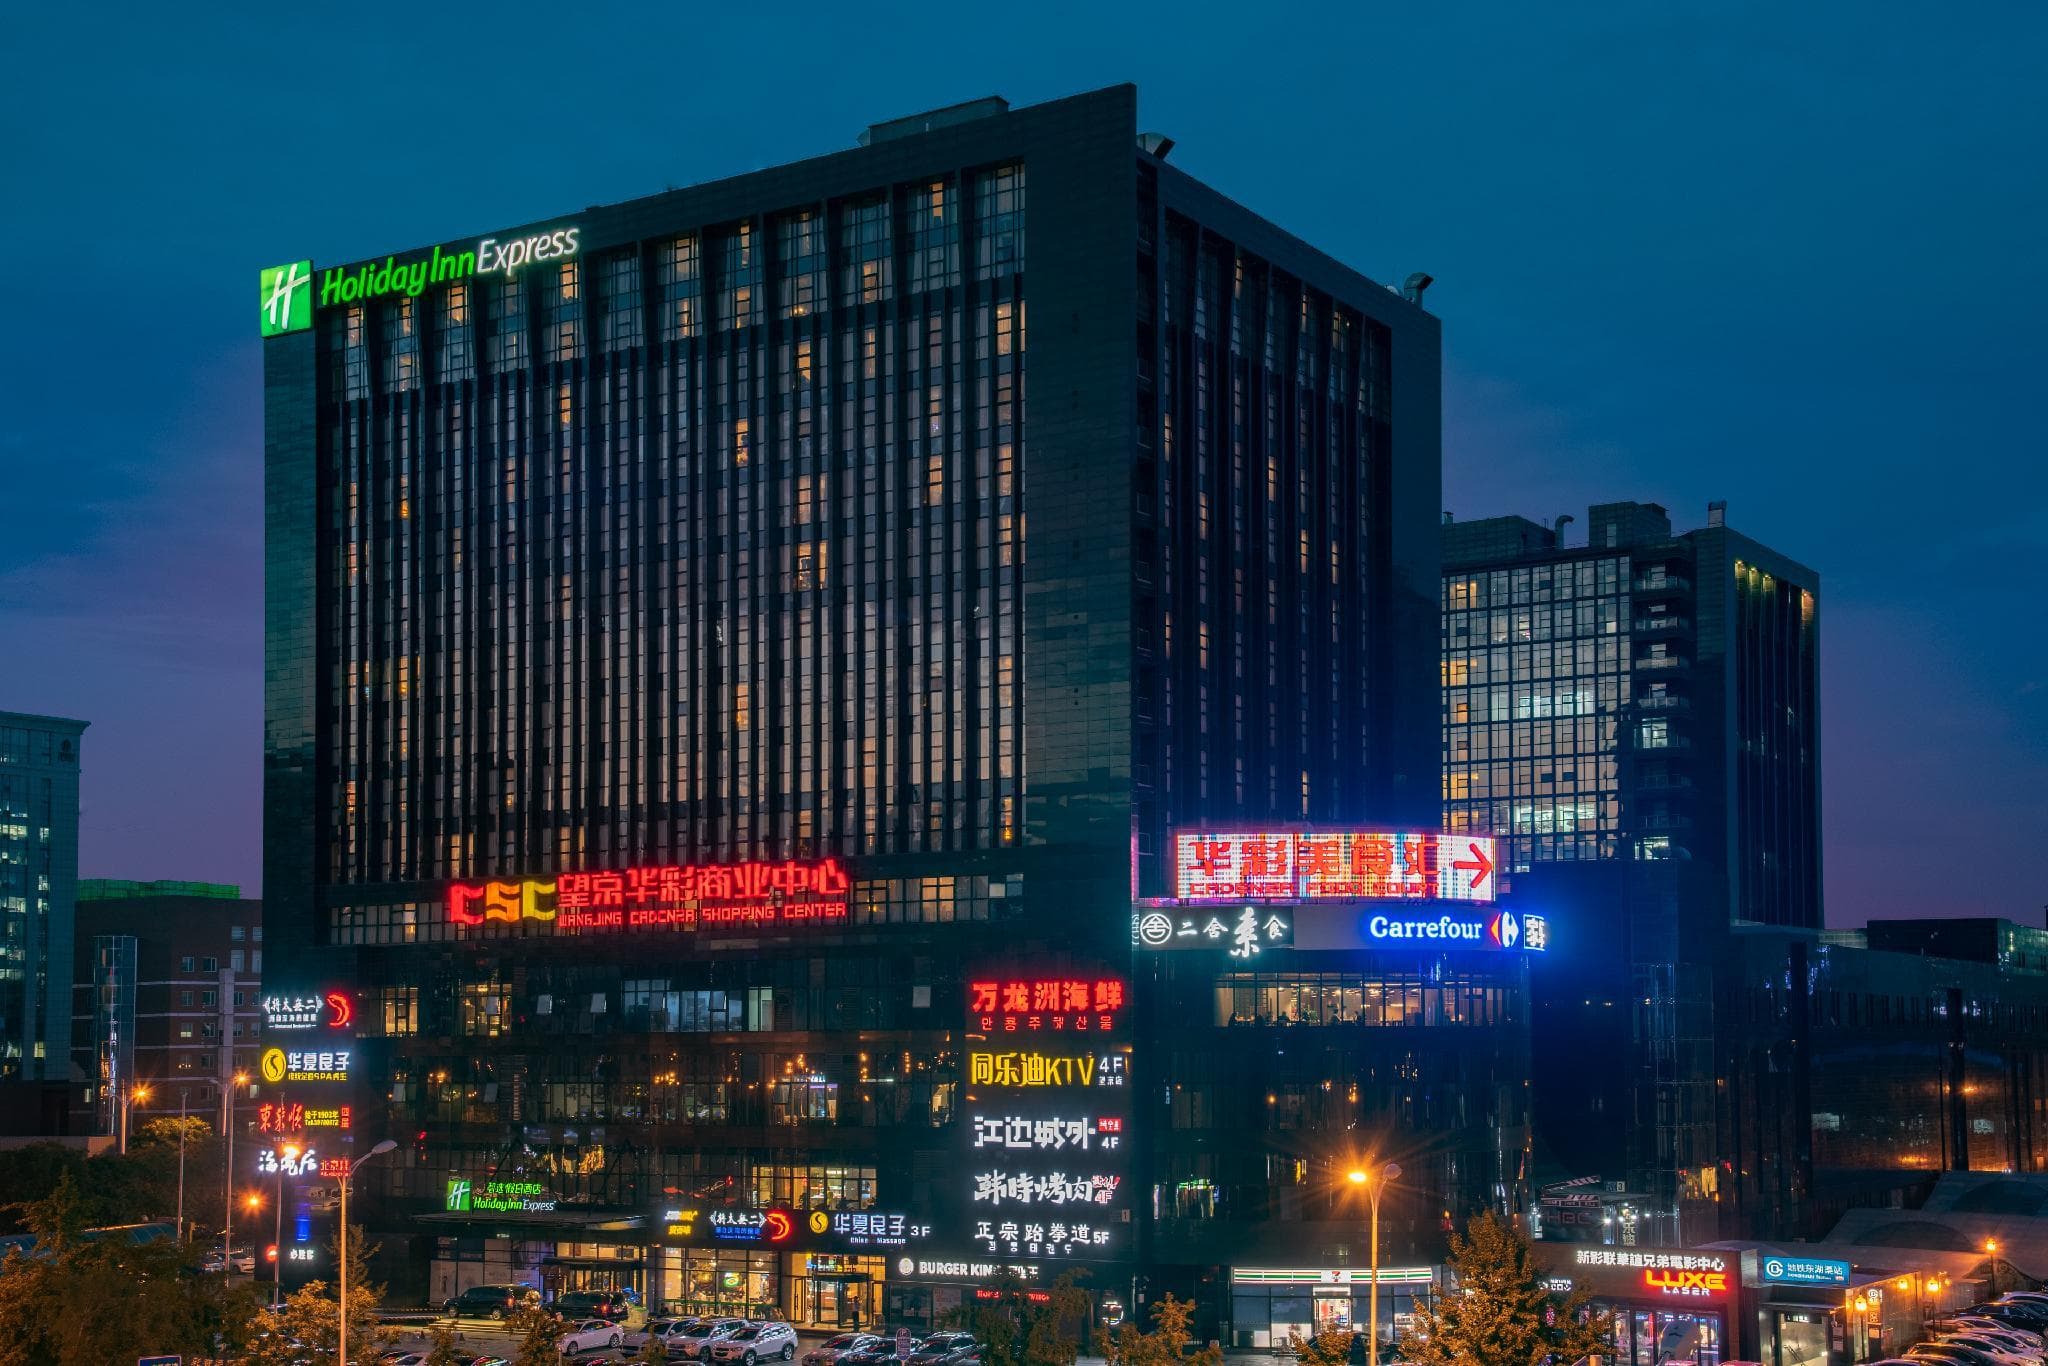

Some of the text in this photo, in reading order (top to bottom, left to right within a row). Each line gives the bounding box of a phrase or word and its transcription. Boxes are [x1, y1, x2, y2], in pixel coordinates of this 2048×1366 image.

[320, 227, 580, 305] Holiday Inn Express
[1187, 839, 1440, 877] 华彩美食汇
[558, 858, 849, 908] 望京华彩商业中心
[1190, 882, 1439, 895] CADENZA FOOD COURT
[559, 909, 622, 928] WANGJING
[702, 905, 774, 922] SHOPPING
[784, 902, 847, 919] CENTER
[1177, 907, 1288, 958] 二舍素食
[1369, 916, 1482, 940] Carrefour
[972, 981, 1122, 1013] 万龙洲海鲜
[288, 1052, 350, 1072] 华夏良子
[971, 1052, 1095, 1087] 同乐迪KTV
[1099, 1057, 1123, 1073] 4F
[974, 1116, 1096, 1150] 江边城外
[1101, 1137, 1119, 1149] 4F
[487, 1182, 543, 1195] 智选假日酒店
[473, 1197, 555, 1213] Holiday Inn Express
[834, 1213, 906, 1236] 华夏良子
[910, 1225, 931, 1237] 3F
[974, 1221, 1091, 1245] 正宗跆拳道
[876, 1237, 906, 1245] Massage
[1093, 1231, 1111, 1244] 5F
[919, 1261, 968, 1276] BURGER
[1646, 1270, 1726, 1290] LUXE
[1663, 1286, 1710, 1296] LASER
